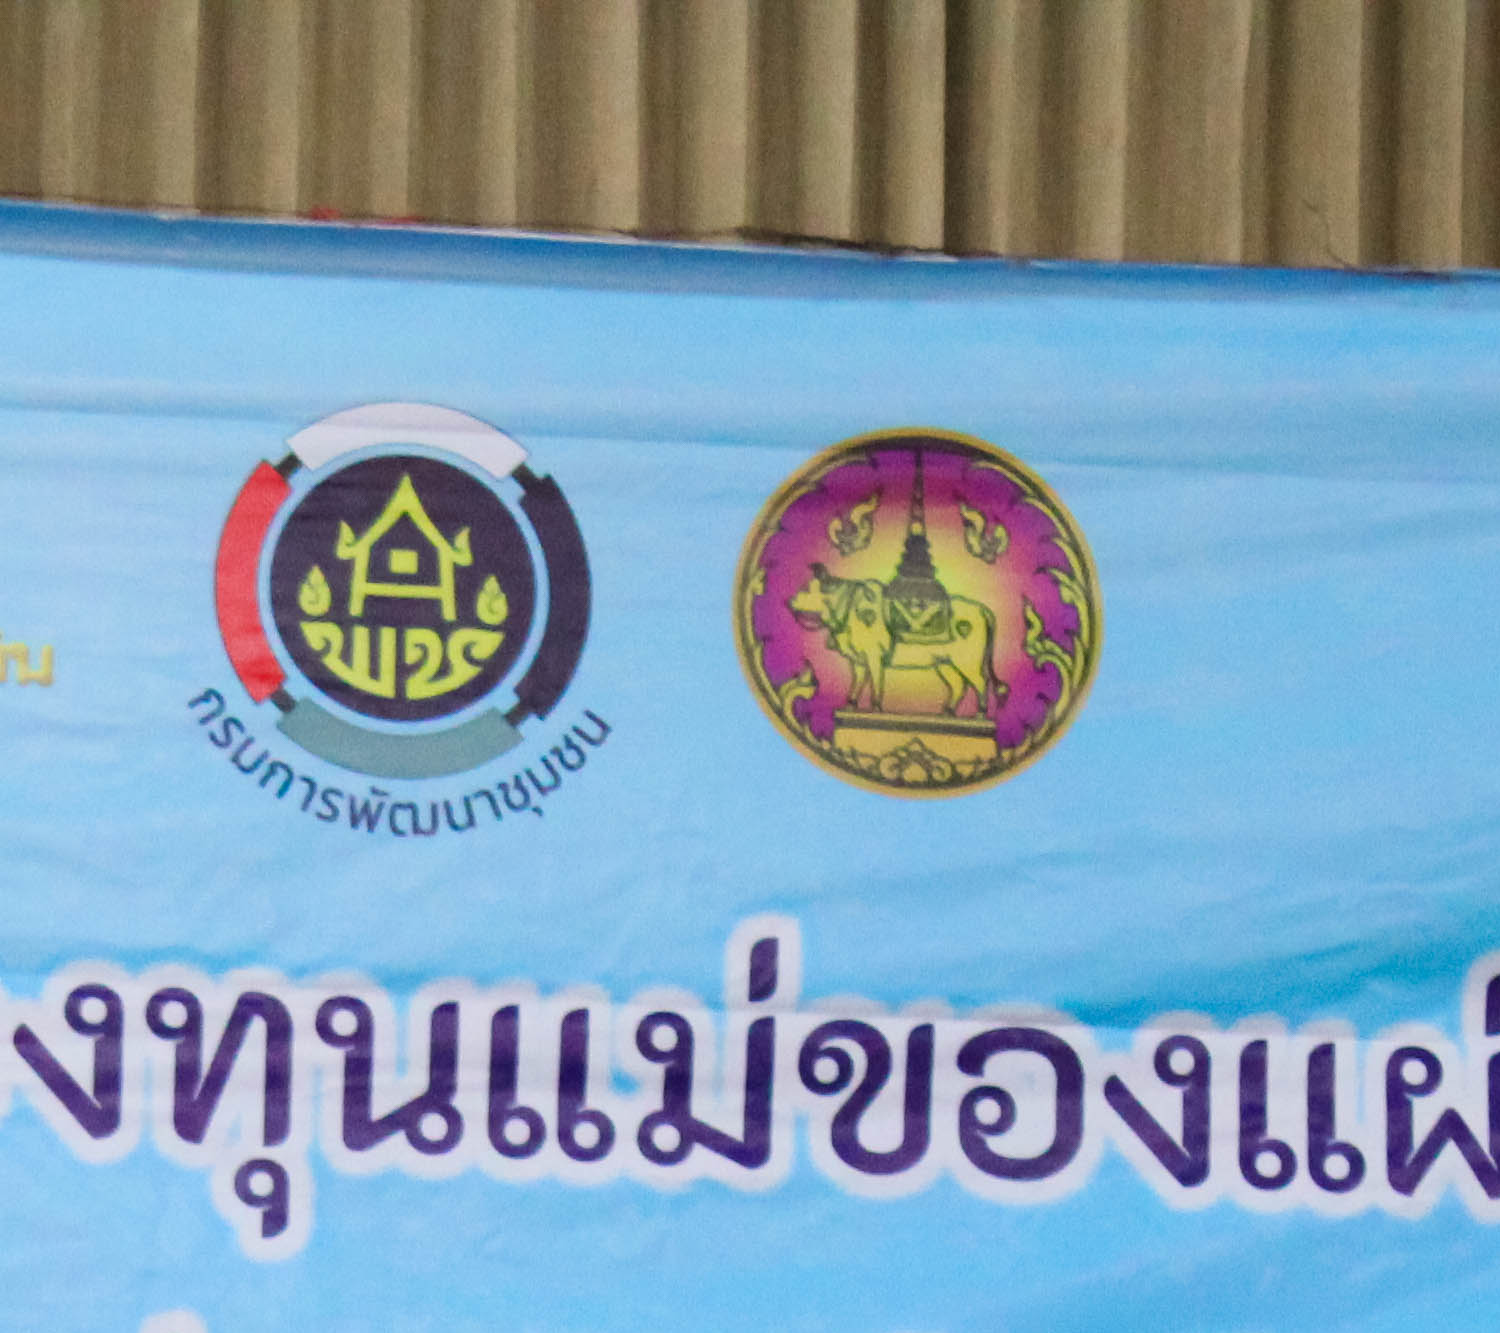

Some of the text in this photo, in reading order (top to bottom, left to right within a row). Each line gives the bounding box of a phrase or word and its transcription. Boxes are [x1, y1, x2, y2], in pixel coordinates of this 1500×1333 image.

[187, 687, 613, 837] กรมการพัฒนาชุมชน
